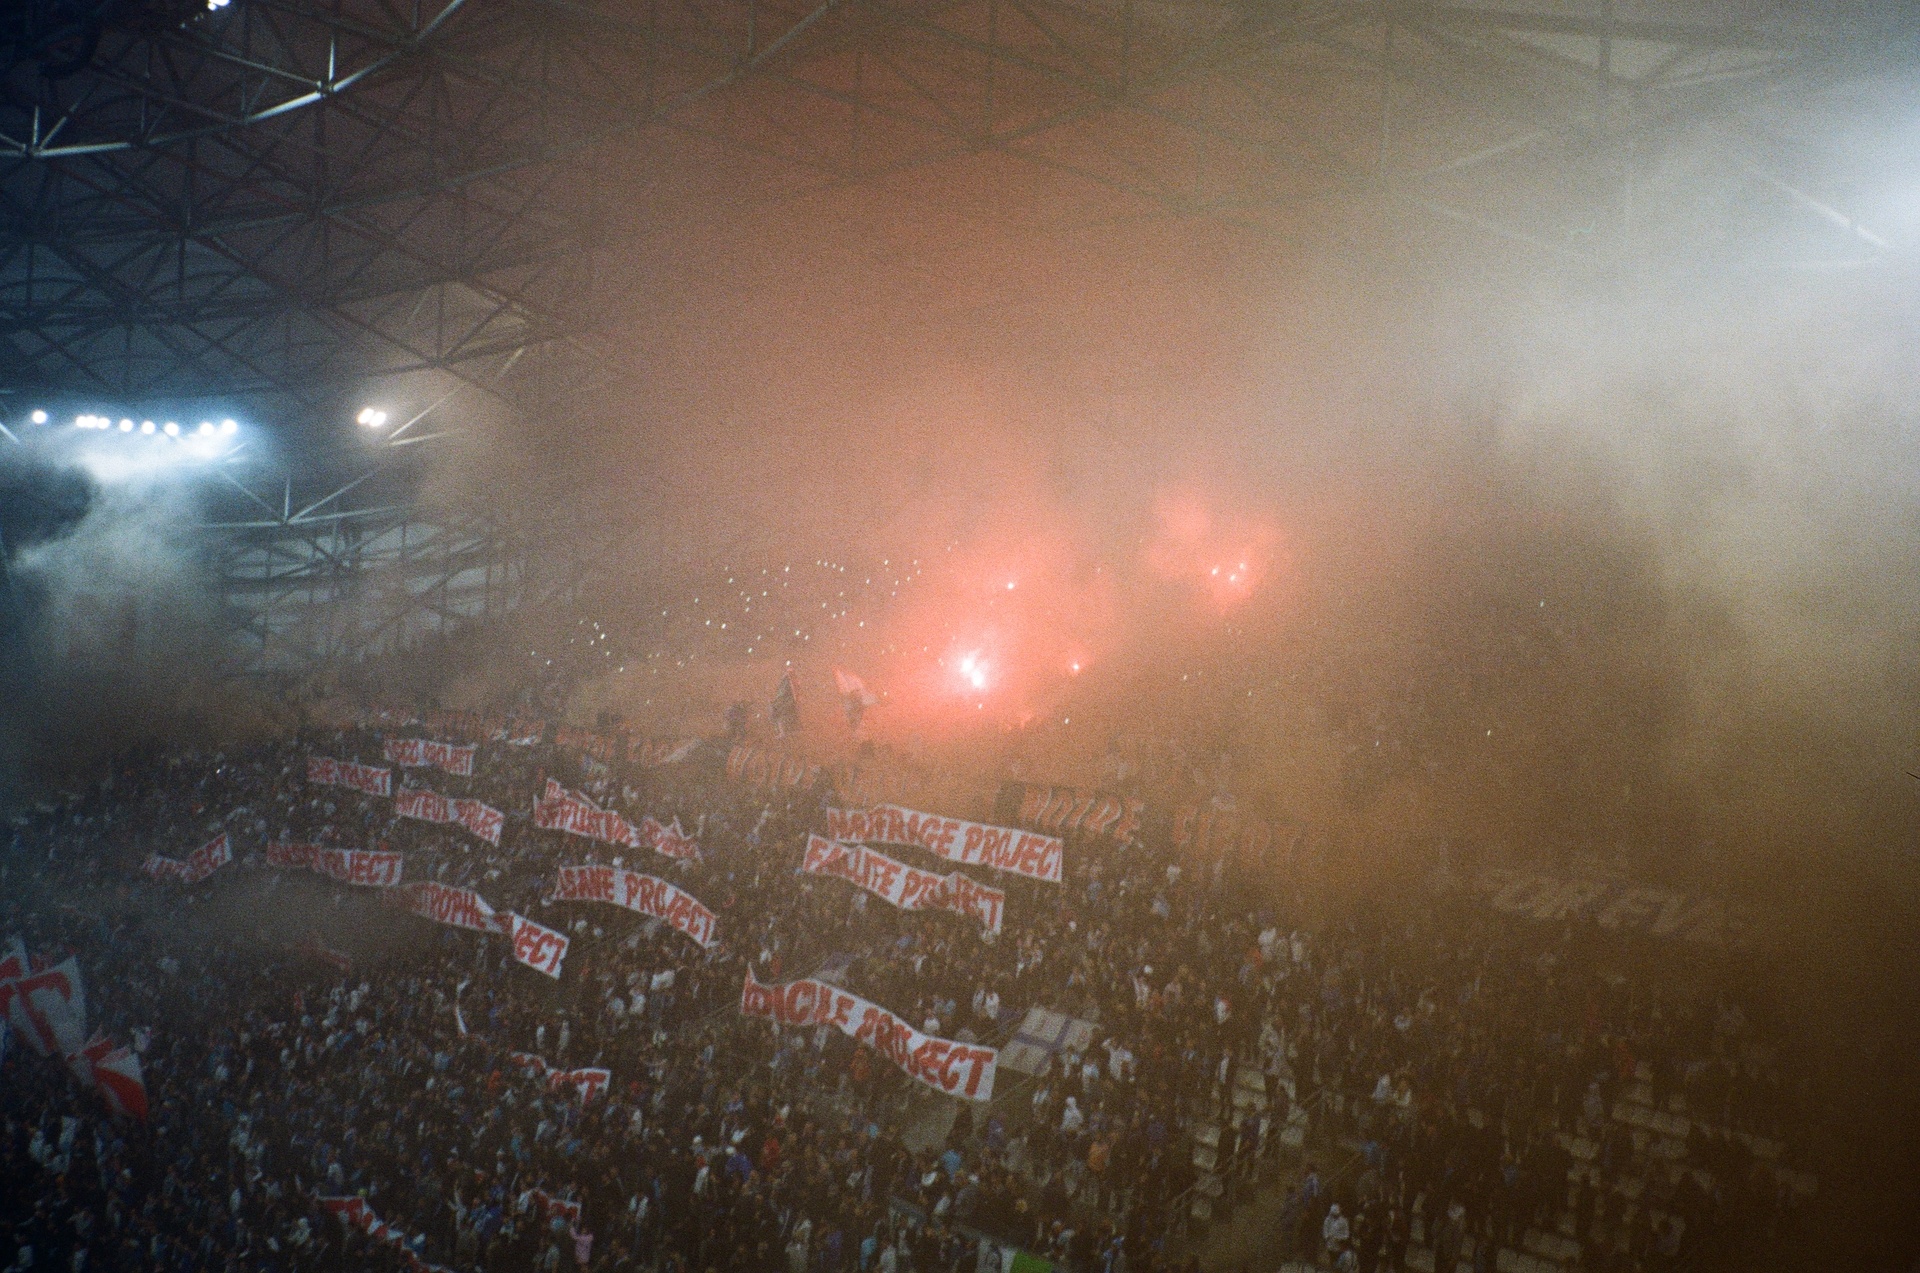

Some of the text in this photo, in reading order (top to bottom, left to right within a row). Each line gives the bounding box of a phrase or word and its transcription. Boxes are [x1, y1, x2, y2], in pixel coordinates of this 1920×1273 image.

[804, 837, 902, 896] FALLITE
[961, 826, 1062, 880] PROJECT
[624, 872, 714, 943] PROJECT
[855, 1008, 994, 1098] PROJECT
